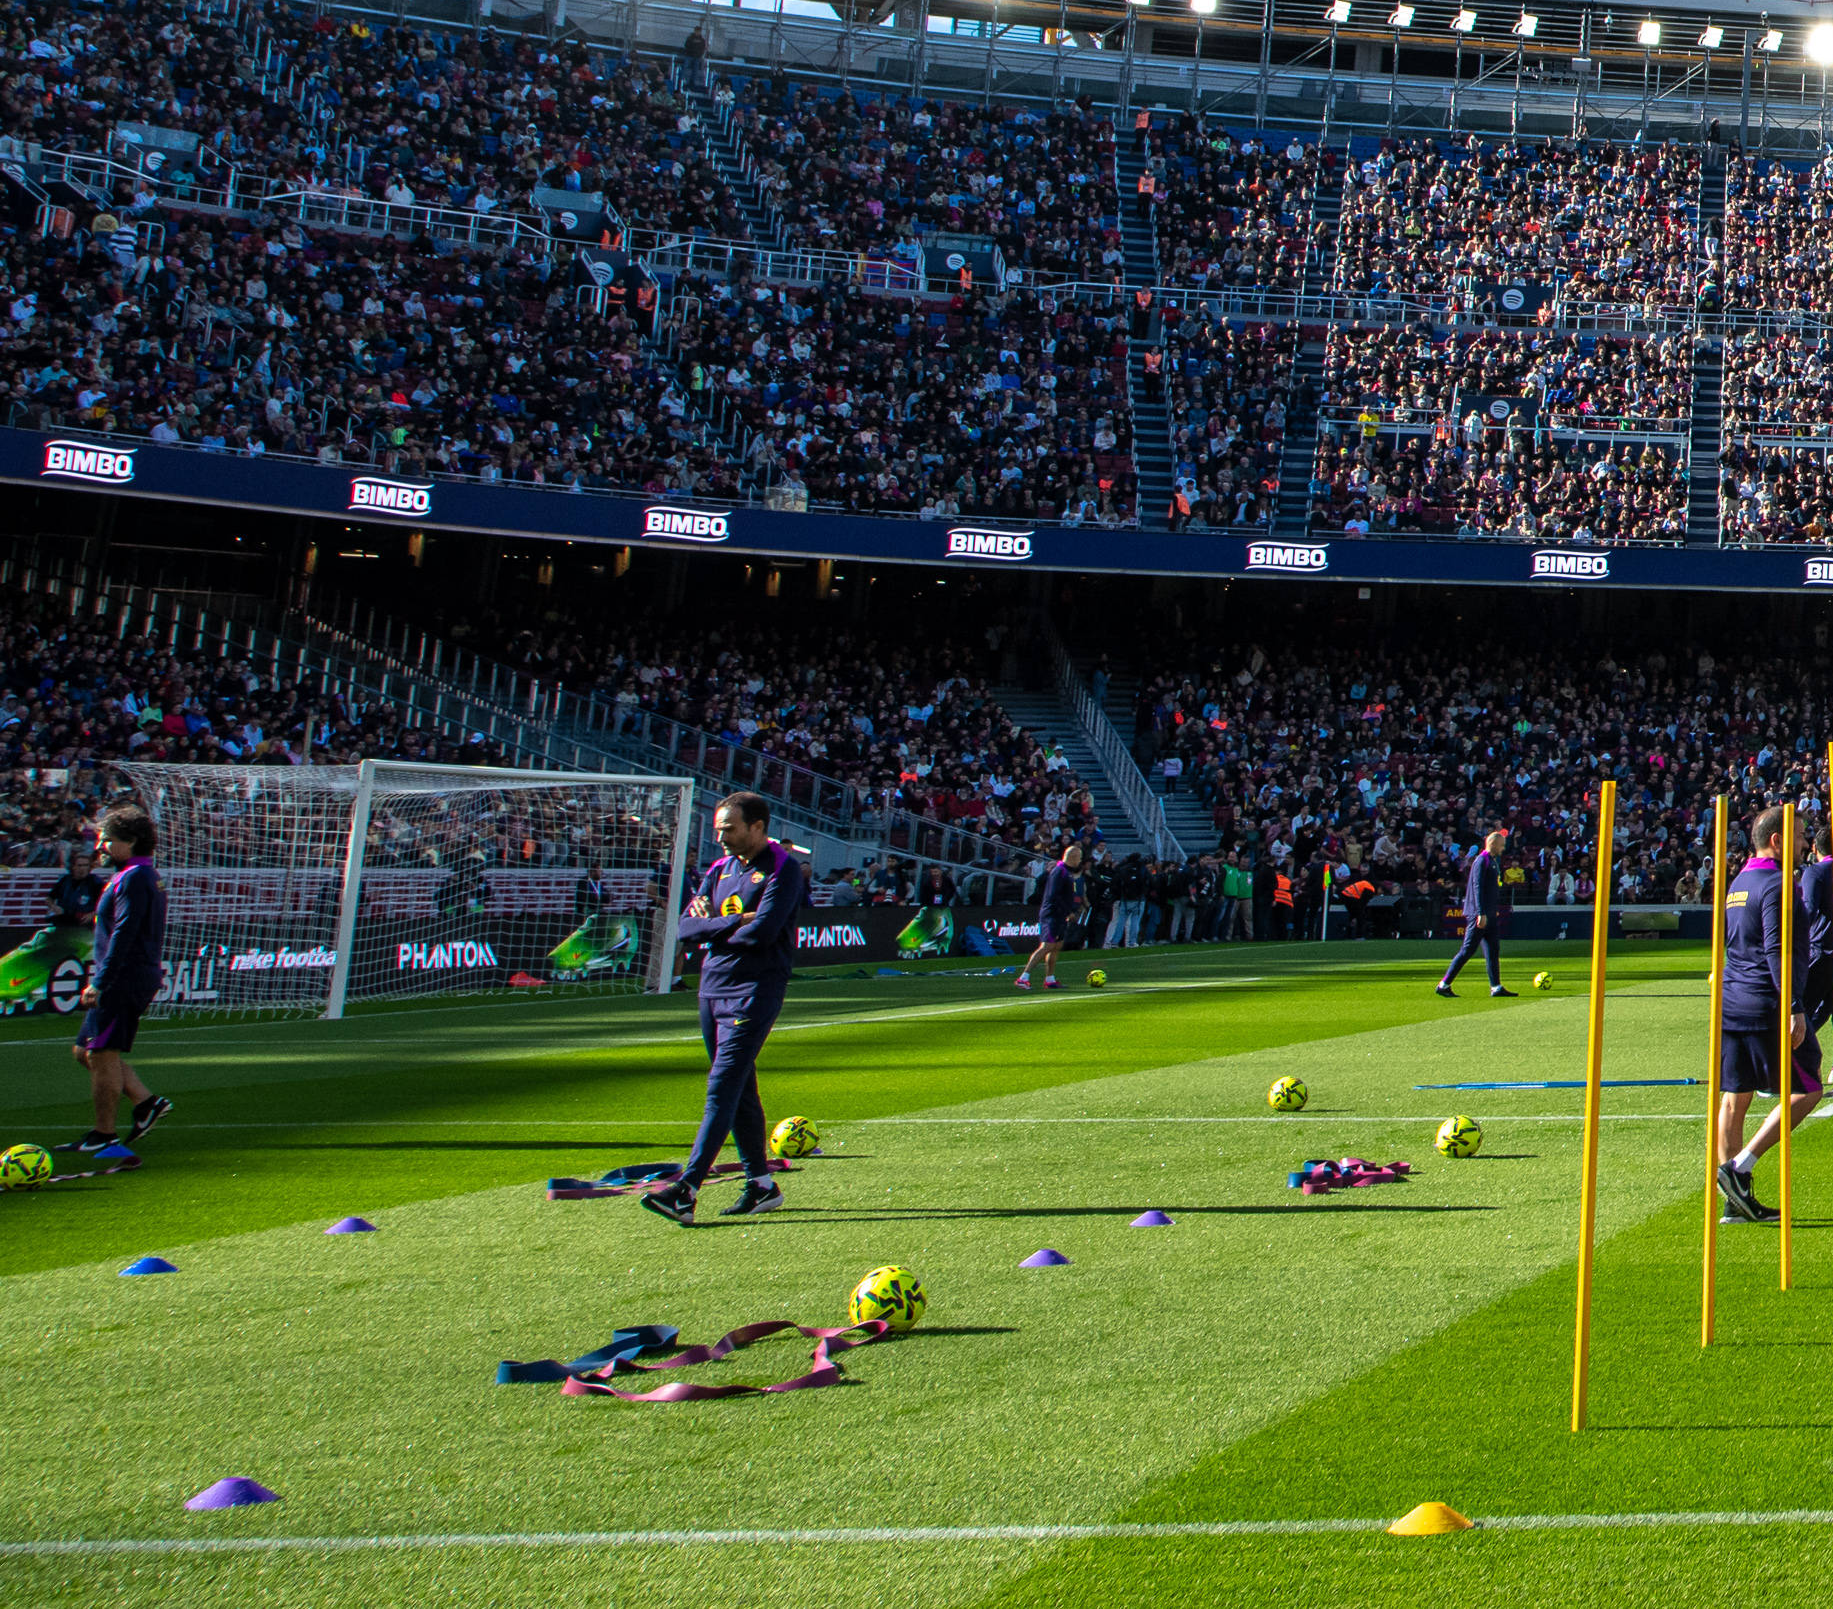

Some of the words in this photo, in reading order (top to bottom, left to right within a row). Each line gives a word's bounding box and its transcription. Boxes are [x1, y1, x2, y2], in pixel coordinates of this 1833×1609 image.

[45, 447, 134, 477] BIMBO
[352, 482, 431, 511] BIMBO
[646, 512, 728, 537] BIMBO
[949, 532, 1032, 555] BIMBO
[1248, 546, 1327, 566] BIMBO
[1533, 554, 1608, 574] BIMBO
[796, 925, 867, 948] PHANTOM
[231, 948, 275, 971] nike
[398, 940, 499, 970] PHANTOM
